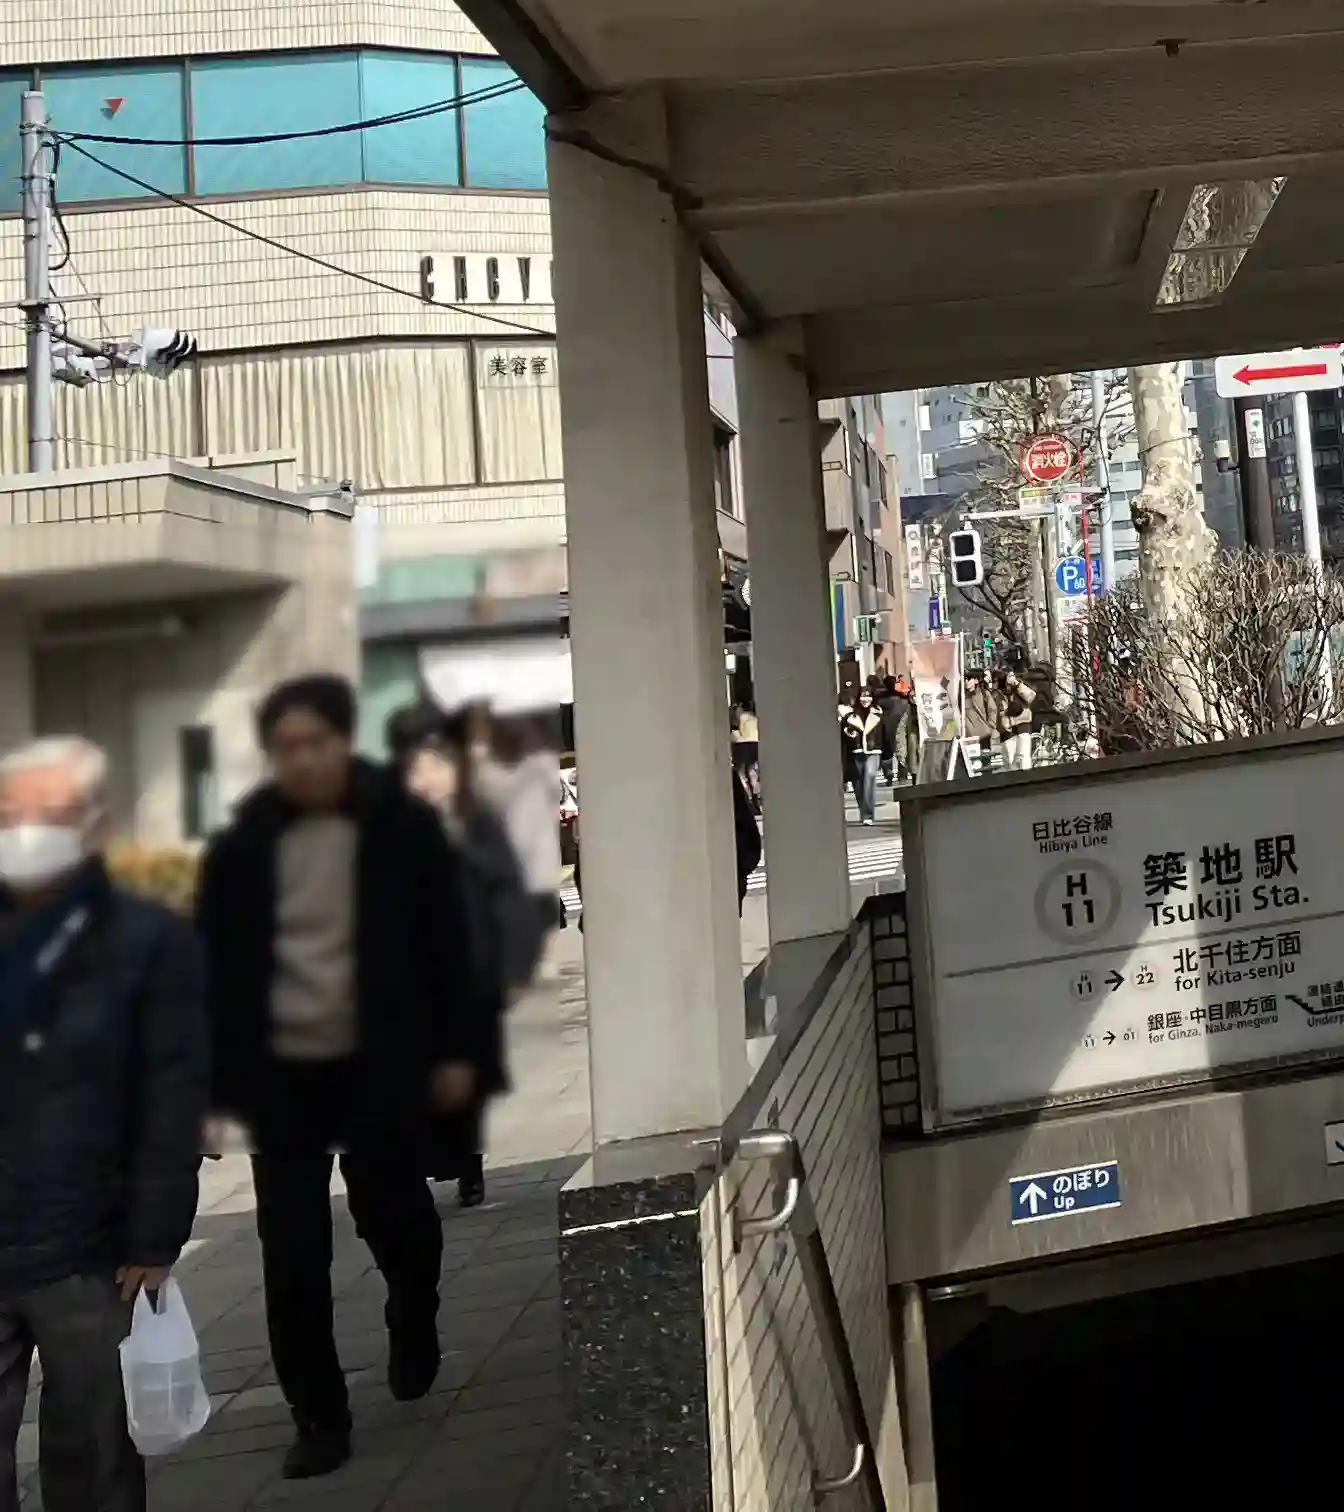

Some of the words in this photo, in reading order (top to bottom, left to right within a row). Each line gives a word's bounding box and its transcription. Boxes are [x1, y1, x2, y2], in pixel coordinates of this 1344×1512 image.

[490, 355, 549, 377] 美容室
[1030, 450, 1068, 474] 消火栓
[1032, 812, 1113, 841] 日比谷線
[1039, 839, 1078, 854] Hibiya
[1082, 834, 1108, 848] Line
[1143, 833, 1299, 897] 築地駅
[1066, 872, 1087, 897] H
[1061, 899, 1094, 927] 11
[1145, 888, 1241, 927] Tsukiji
[1252, 884, 1310, 911] Sta.
[1173, 930, 1302, 974] 北千住方面
[1077, 980, 1093, 995] 11
[1135, 972, 1155, 985] 22
[1174, 975, 1201, 992] for
[1207, 960, 1295, 988] Kita-senju
[1147, 994, 1278, 1032] 銀座・中目黒方面
[1123, 1031, 1136, 1041] 01
[1148, 1031, 1165, 1044] for
[1052, 1169, 1110, 1194] のぼり
[1053, 1195, 1076, 1210] Up
